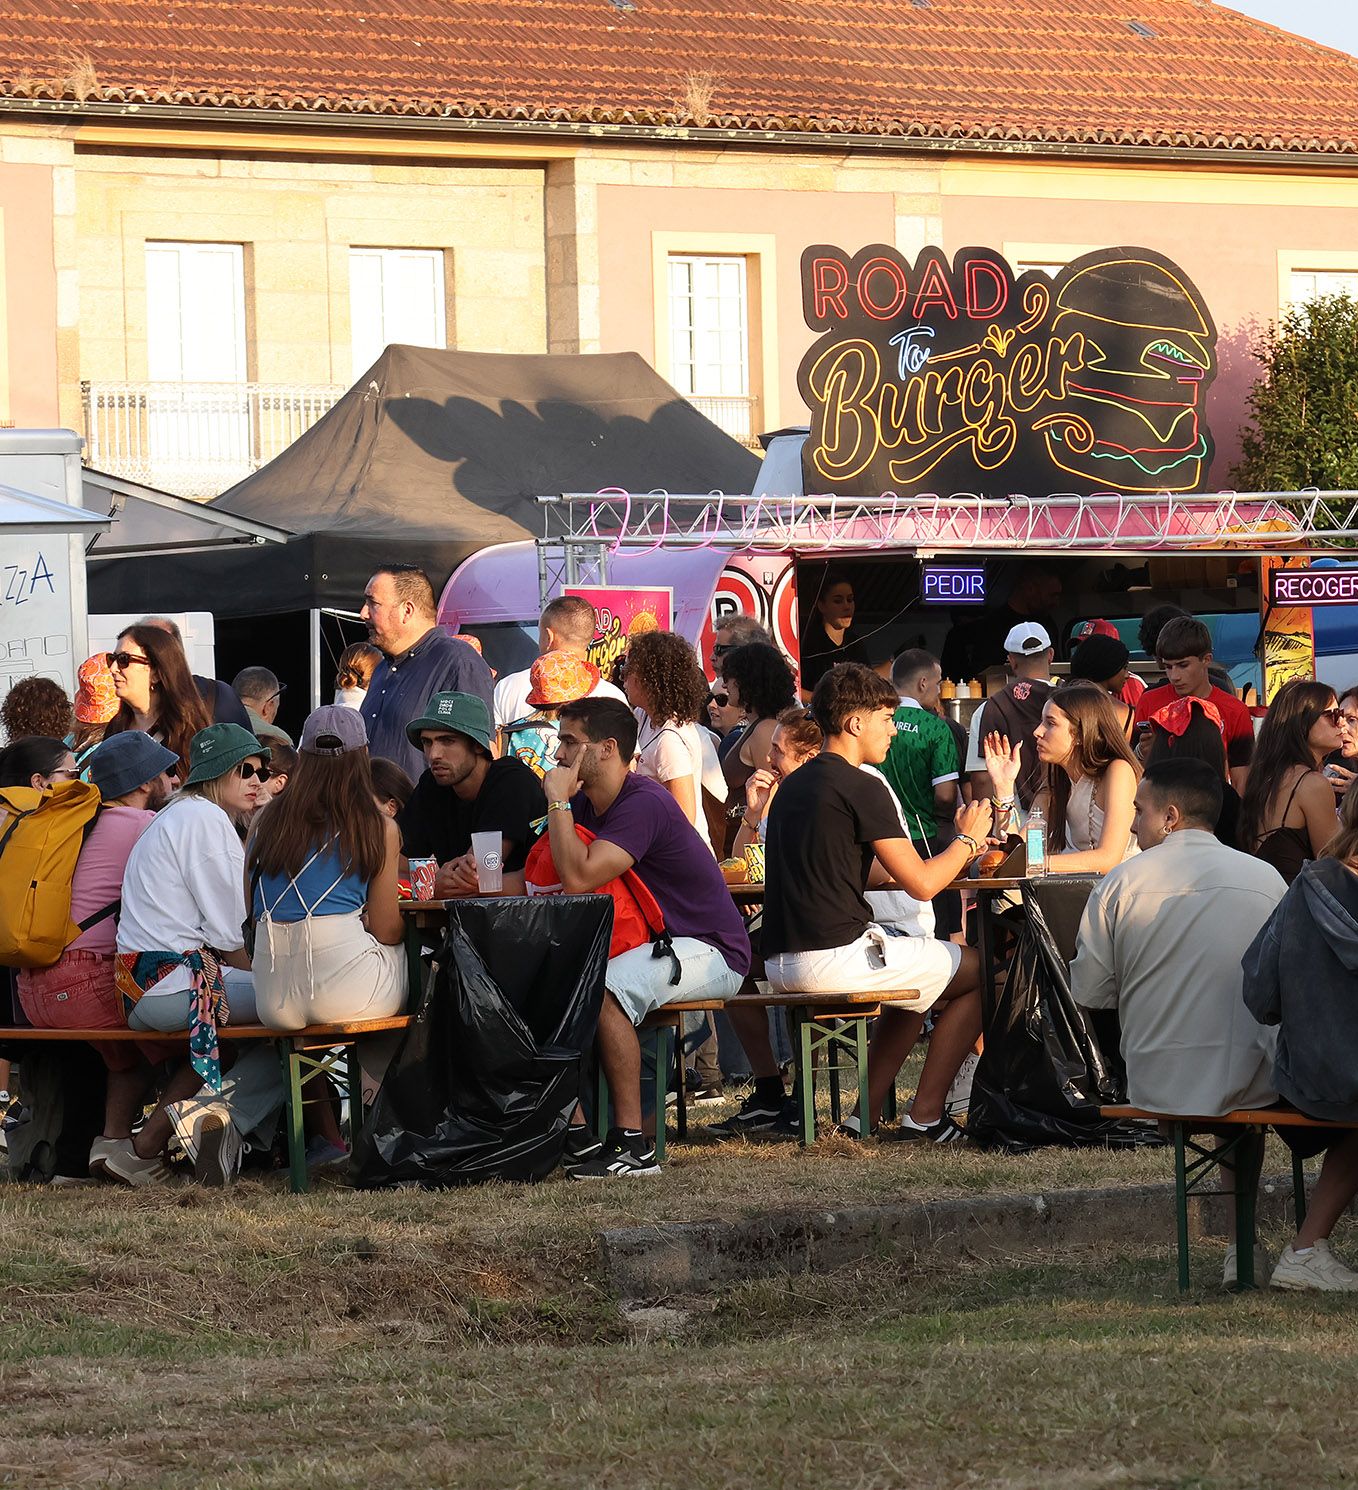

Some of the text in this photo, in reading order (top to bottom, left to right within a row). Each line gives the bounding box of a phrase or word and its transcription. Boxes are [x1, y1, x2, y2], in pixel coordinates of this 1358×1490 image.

[813, 257, 1009, 321] ROAD
[888, 326, 935, 381] To
[809, 331, 1086, 483] Burger
[0, 551, 55, 606] ZZA
[924, 574, 985, 595] PEDIR
[584, 635, 626, 680] urger
[893, 721, 919, 734] URELA
